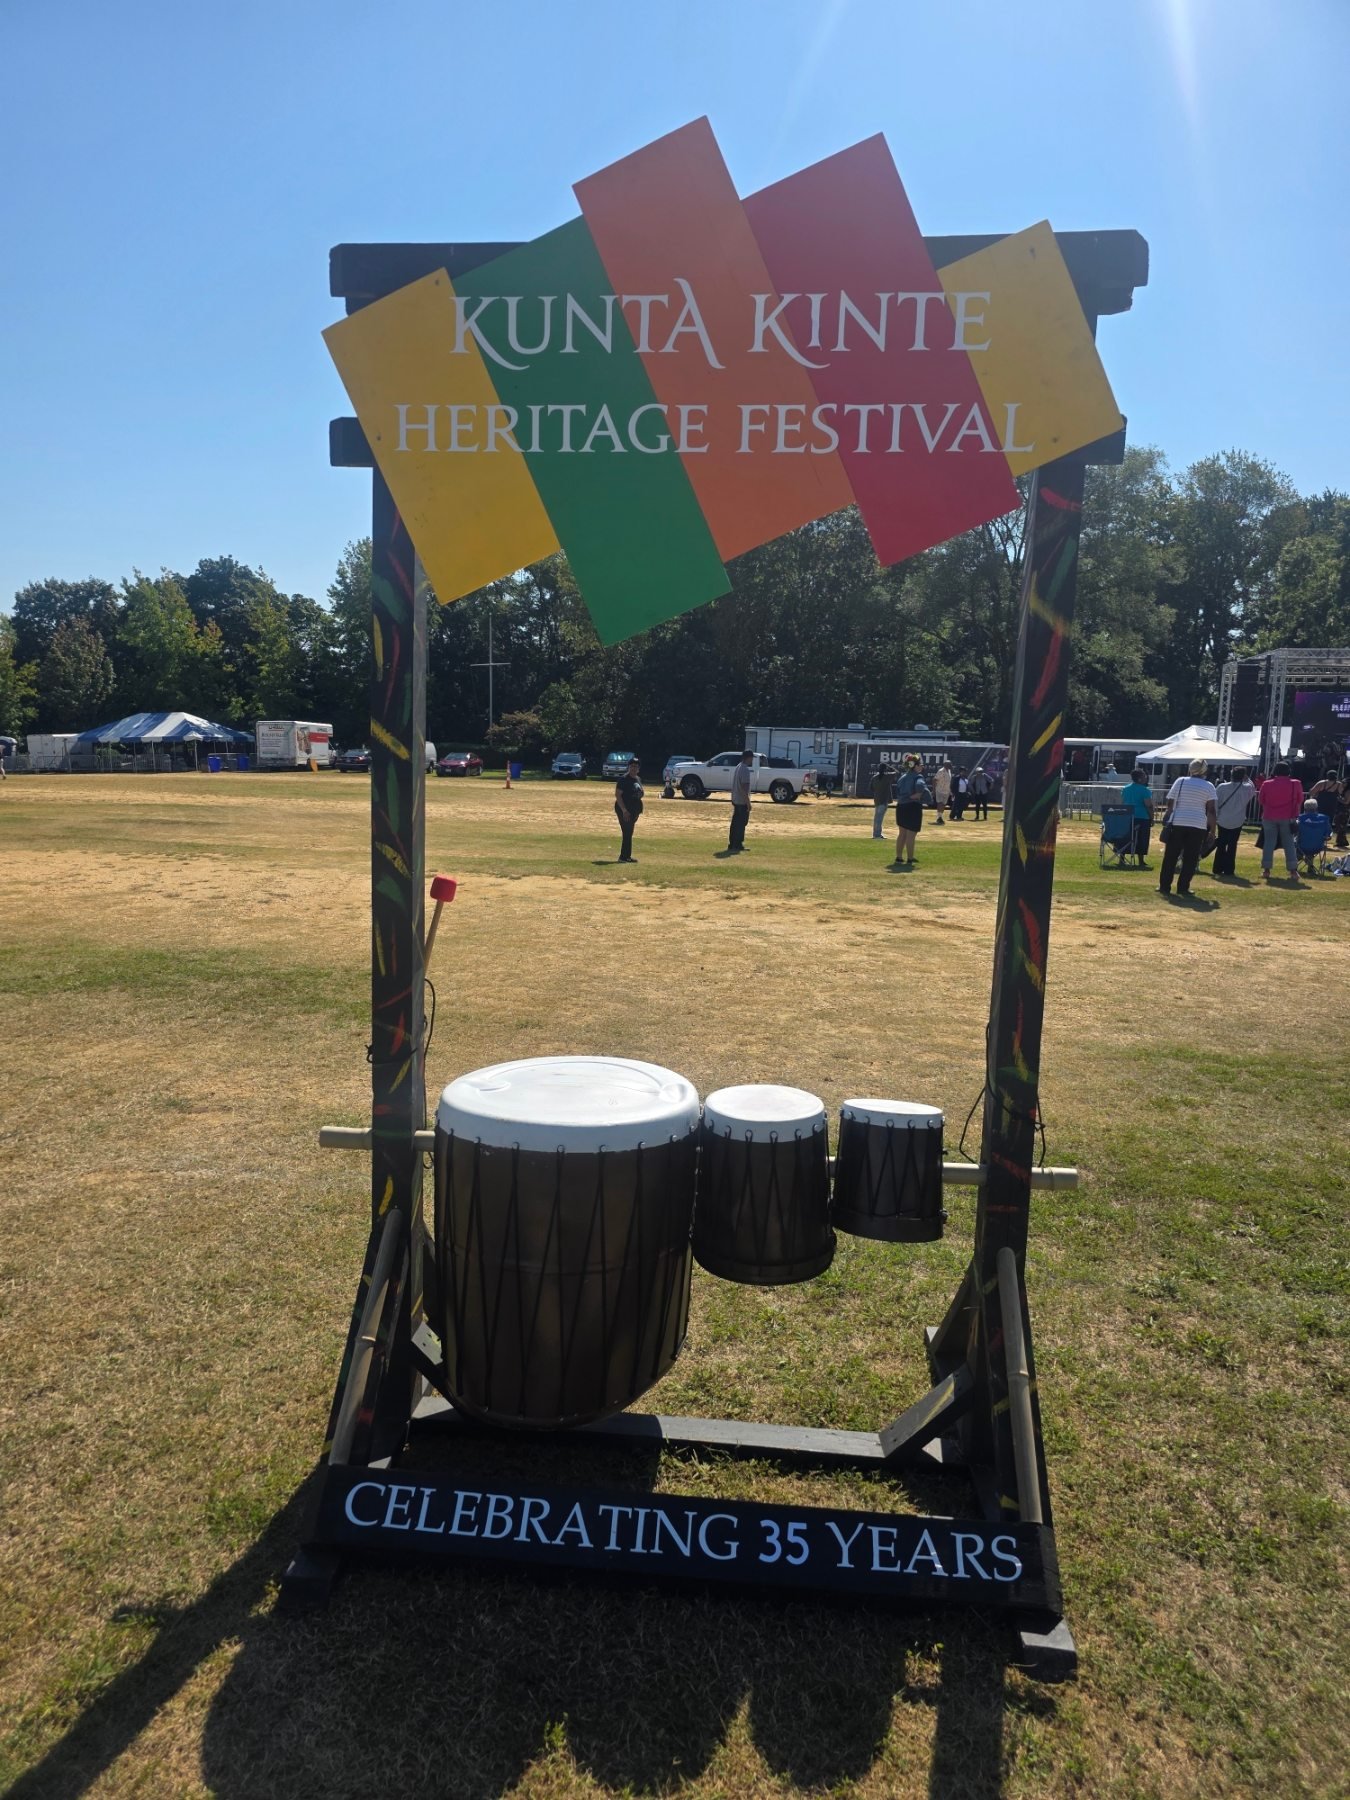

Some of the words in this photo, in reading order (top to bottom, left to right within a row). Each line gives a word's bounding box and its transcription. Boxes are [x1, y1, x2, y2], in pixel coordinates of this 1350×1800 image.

[450, 277, 727, 371] KUNTA
[747, 288, 993, 370] KINTE
[394, 402, 710, 455] HERITAGE
[737, 401, 1036, 455] FESTIVAL
[345, 1482, 740, 1560] CELEBRATING
[758, 1519, 811, 1565] 35
[825, 1521, 1023, 1582] YEARS
